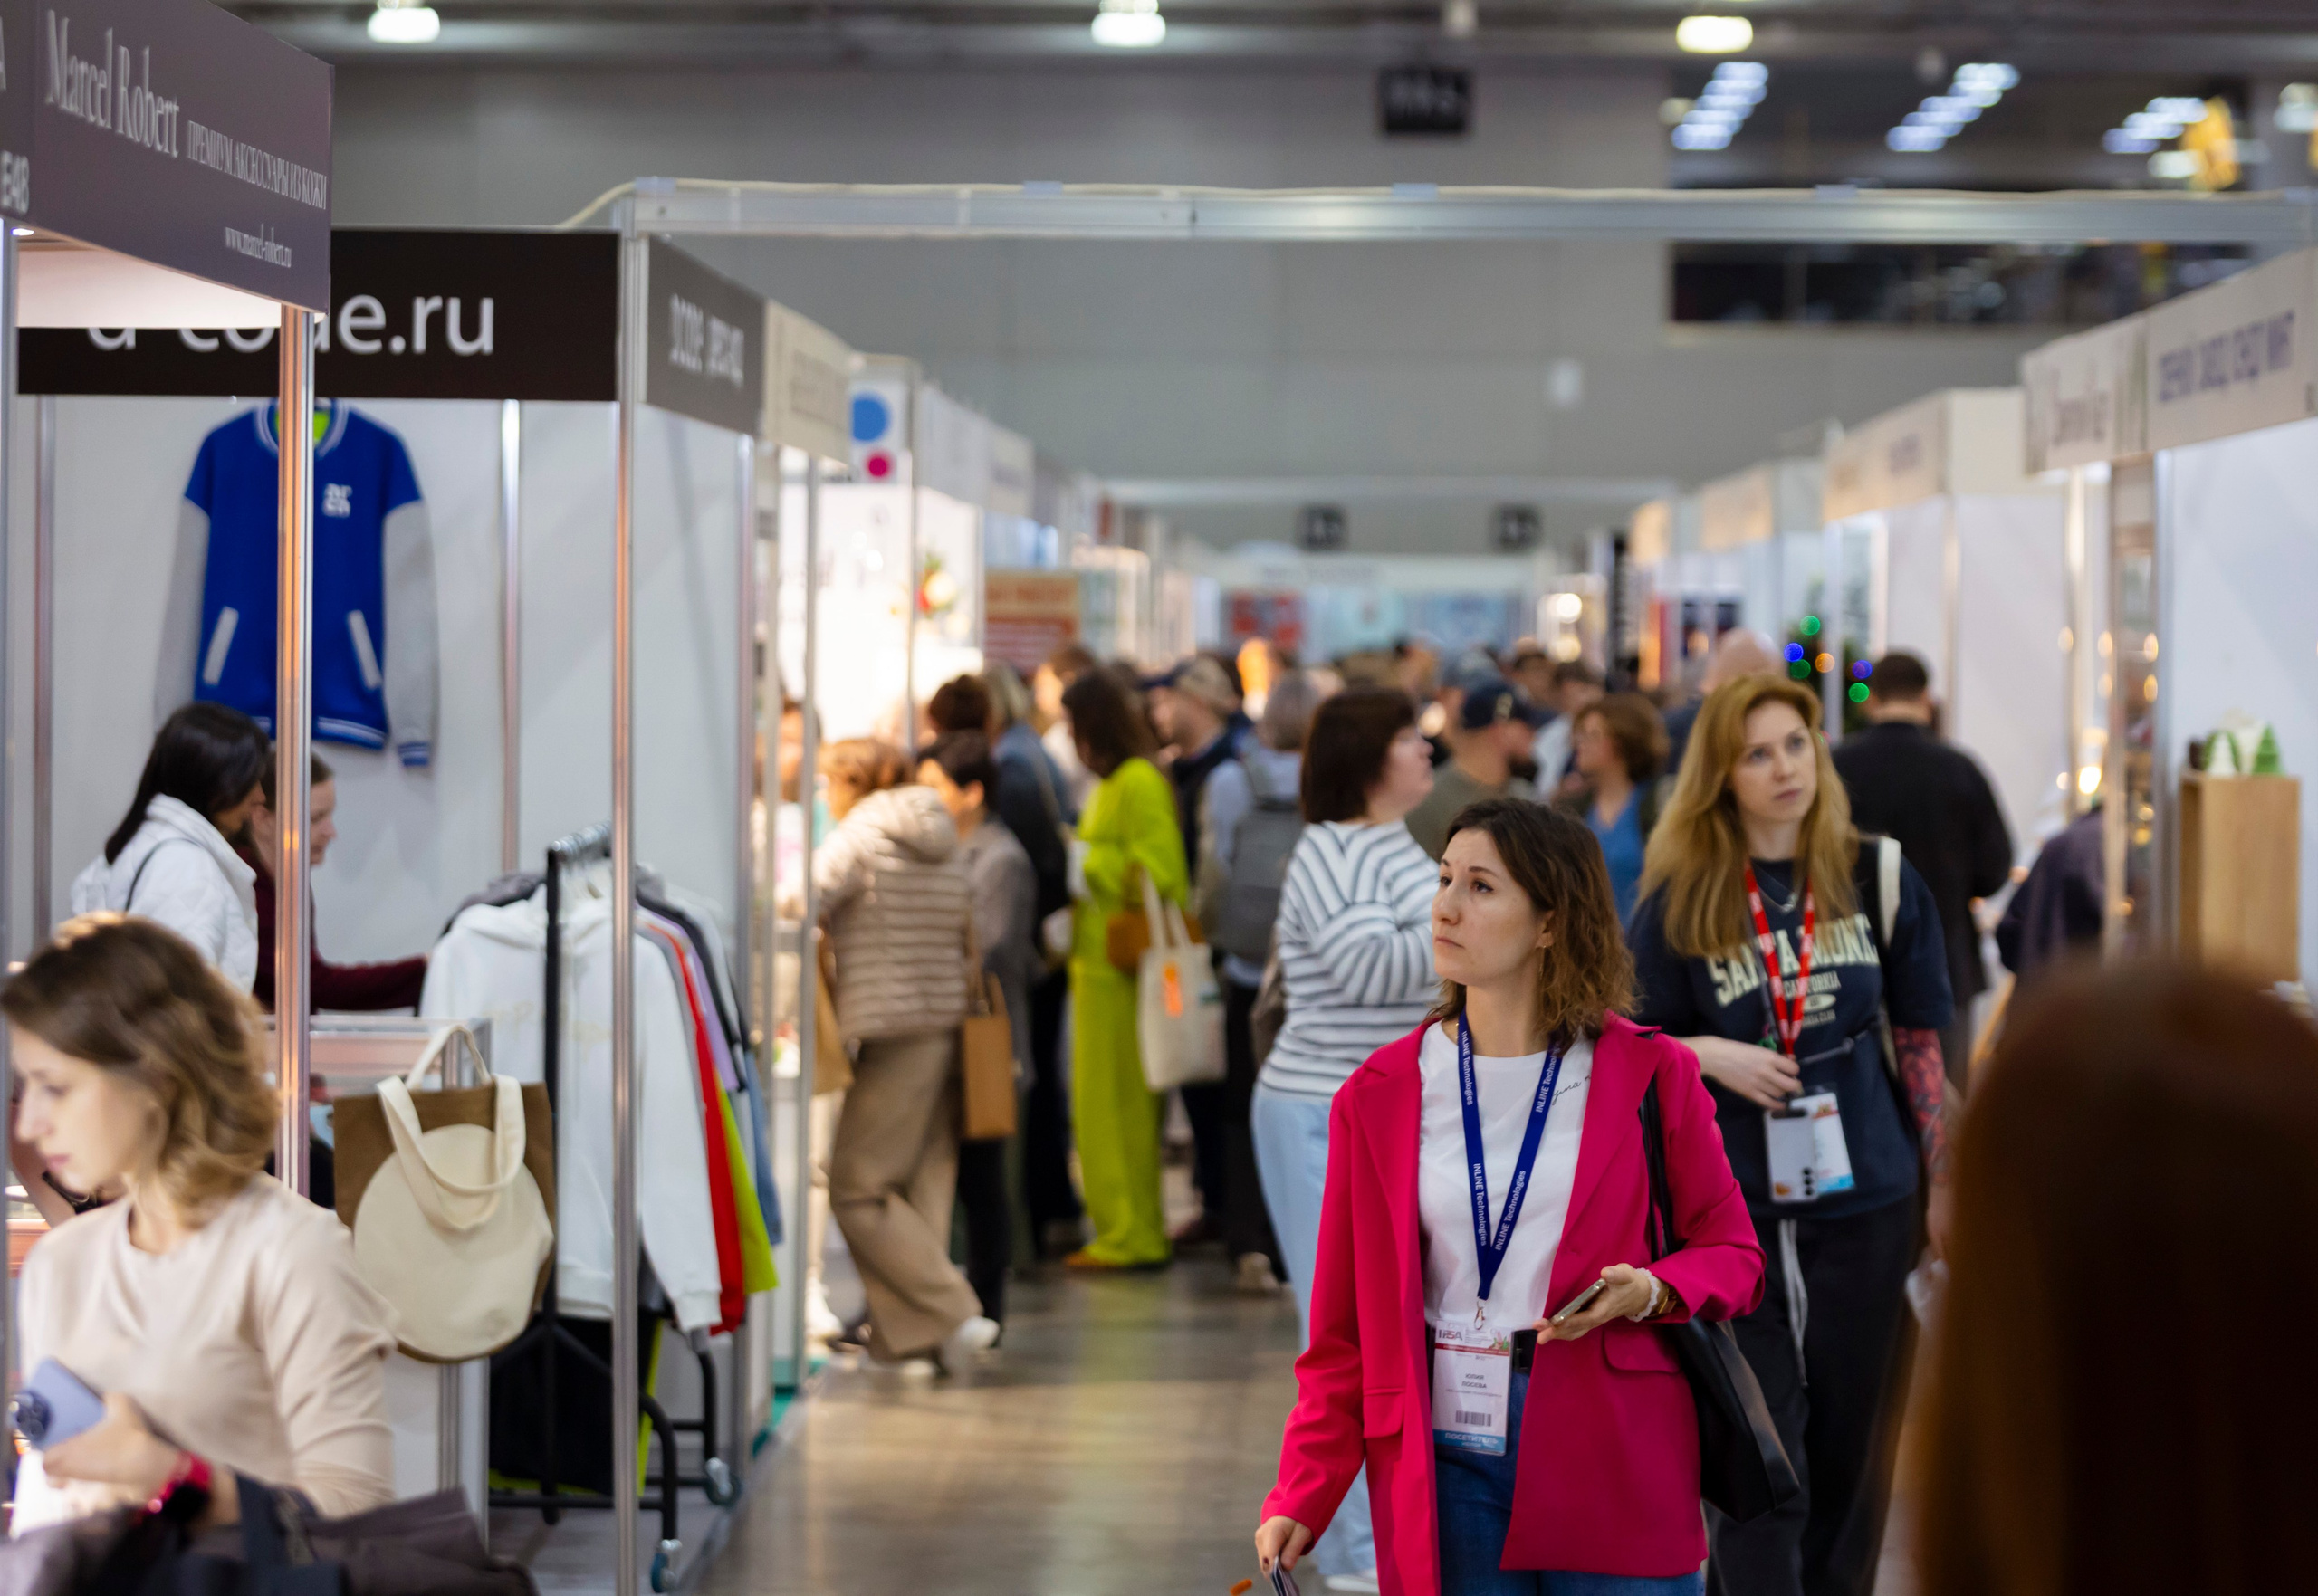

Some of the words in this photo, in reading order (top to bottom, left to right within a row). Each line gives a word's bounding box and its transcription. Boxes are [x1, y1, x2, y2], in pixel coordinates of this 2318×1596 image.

[46, 8, 113, 129] Marcel
[115, 45, 180, 158] Robert
[302, 167, 328, 210] КОЖИ
[1461, 1030, 1470, 1056] INLINE
[1462, 1056, 1473, 1106] Technologies
[1535, 1085, 1549, 1113] INLINE
[1543, 1047, 1557, 1085] Technol
[1473, 1163, 1484, 1190] INLINE
[1501, 1170, 1527, 1222] Technologies
[1476, 1190, 1488, 1247] Technologies
[1495, 1223, 1510, 1251] INLINE
